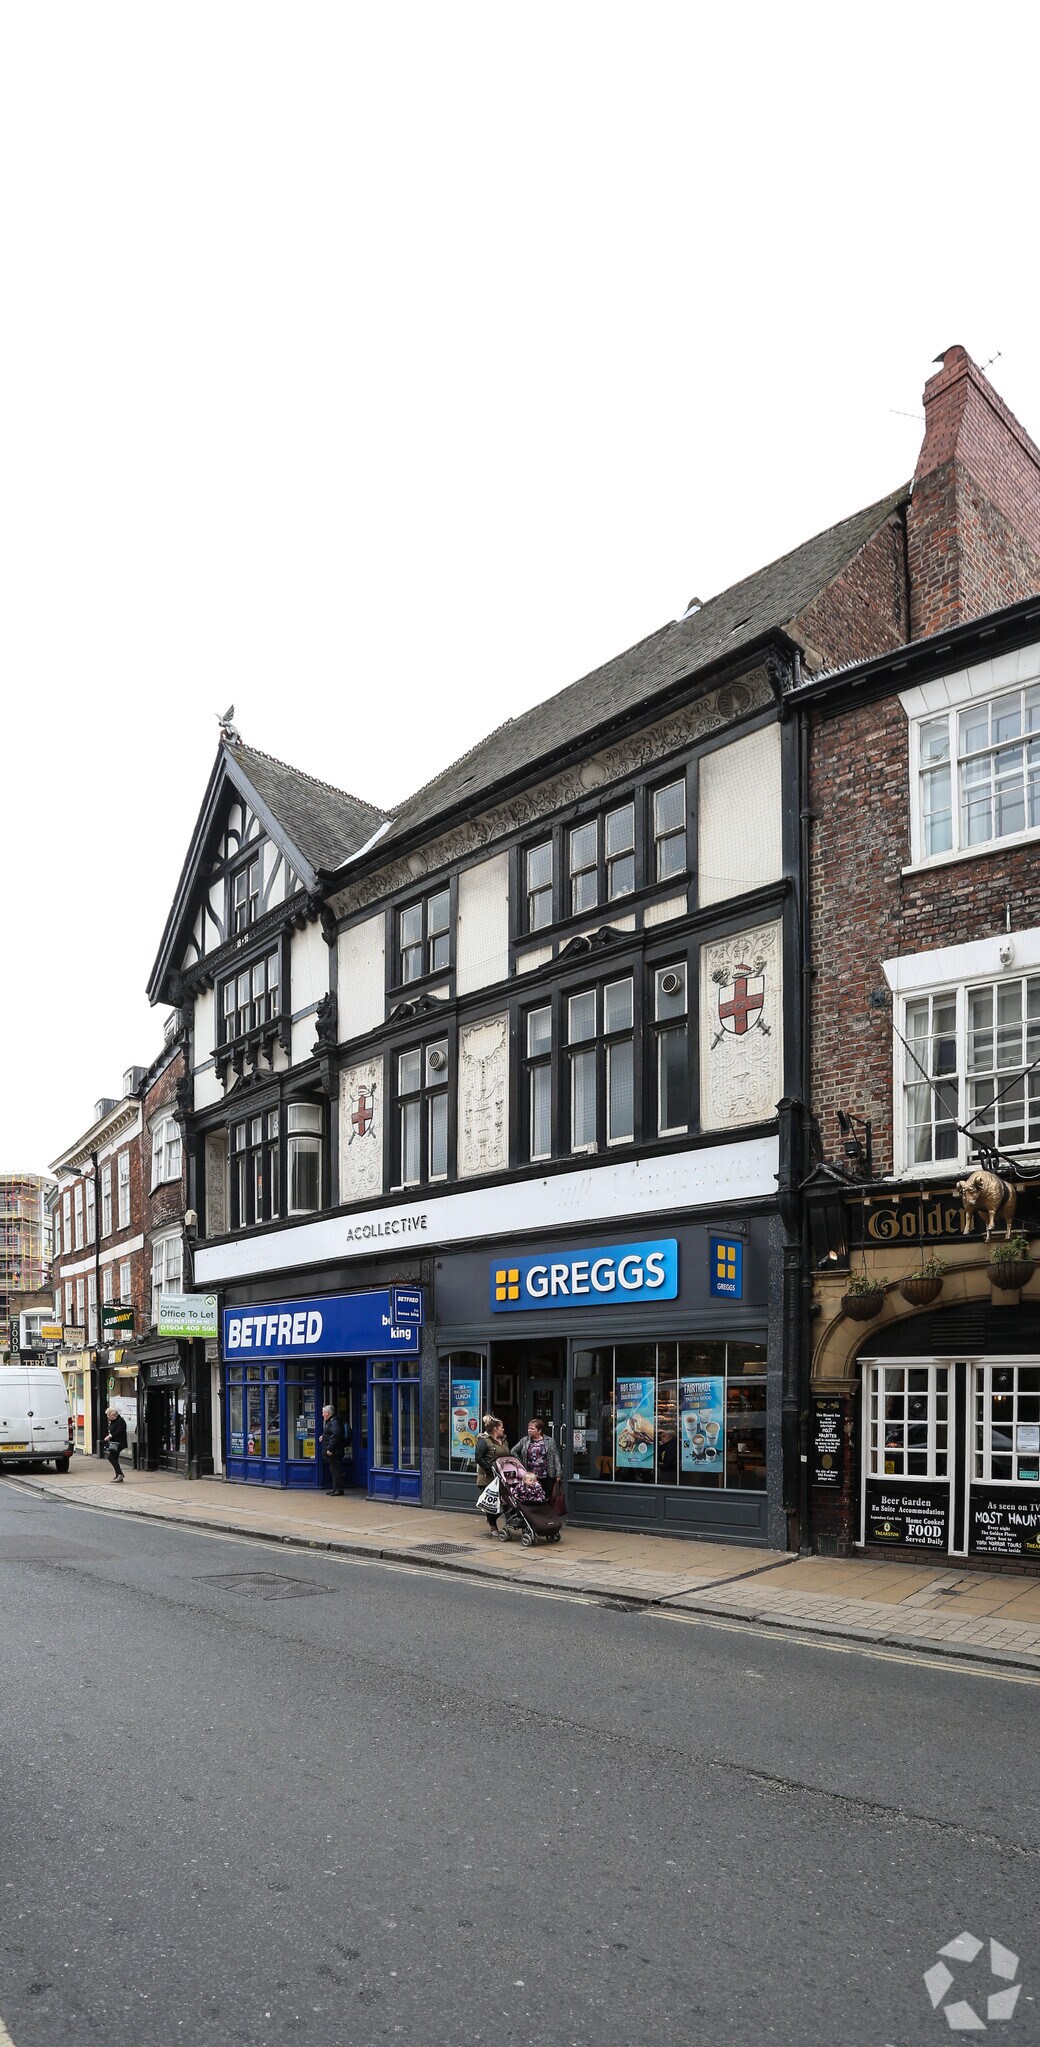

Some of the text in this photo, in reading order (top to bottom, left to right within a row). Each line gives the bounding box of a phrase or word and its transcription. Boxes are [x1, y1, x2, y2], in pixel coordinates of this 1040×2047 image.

[346, 1214, 428, 1241] ACOLLECTIVE
[526, 1252, 666, 1298] GREGGS
[716, 1282, 736, 1292] GREGGS
[104, 1312, 132, 1326] SUBWAY
[160, 1310, 186, 1318] Office
[228, 1310, 323, 1348] BETFRED
[390, 1326, 412, 1340] king
[620, 1382, 642, 1392] HOT STEAK
[684, 1382, 712, 1394] FAIRTRADE
[484, 1494, 498, 1504] TOP
[881, 1496, 931, 1506] Beer Garden
[899, 1507, 945, 1515] Accommodation
[975, 1512, 1003, 1524] MOST
[908, 1524, 941, 1537] FOOD
